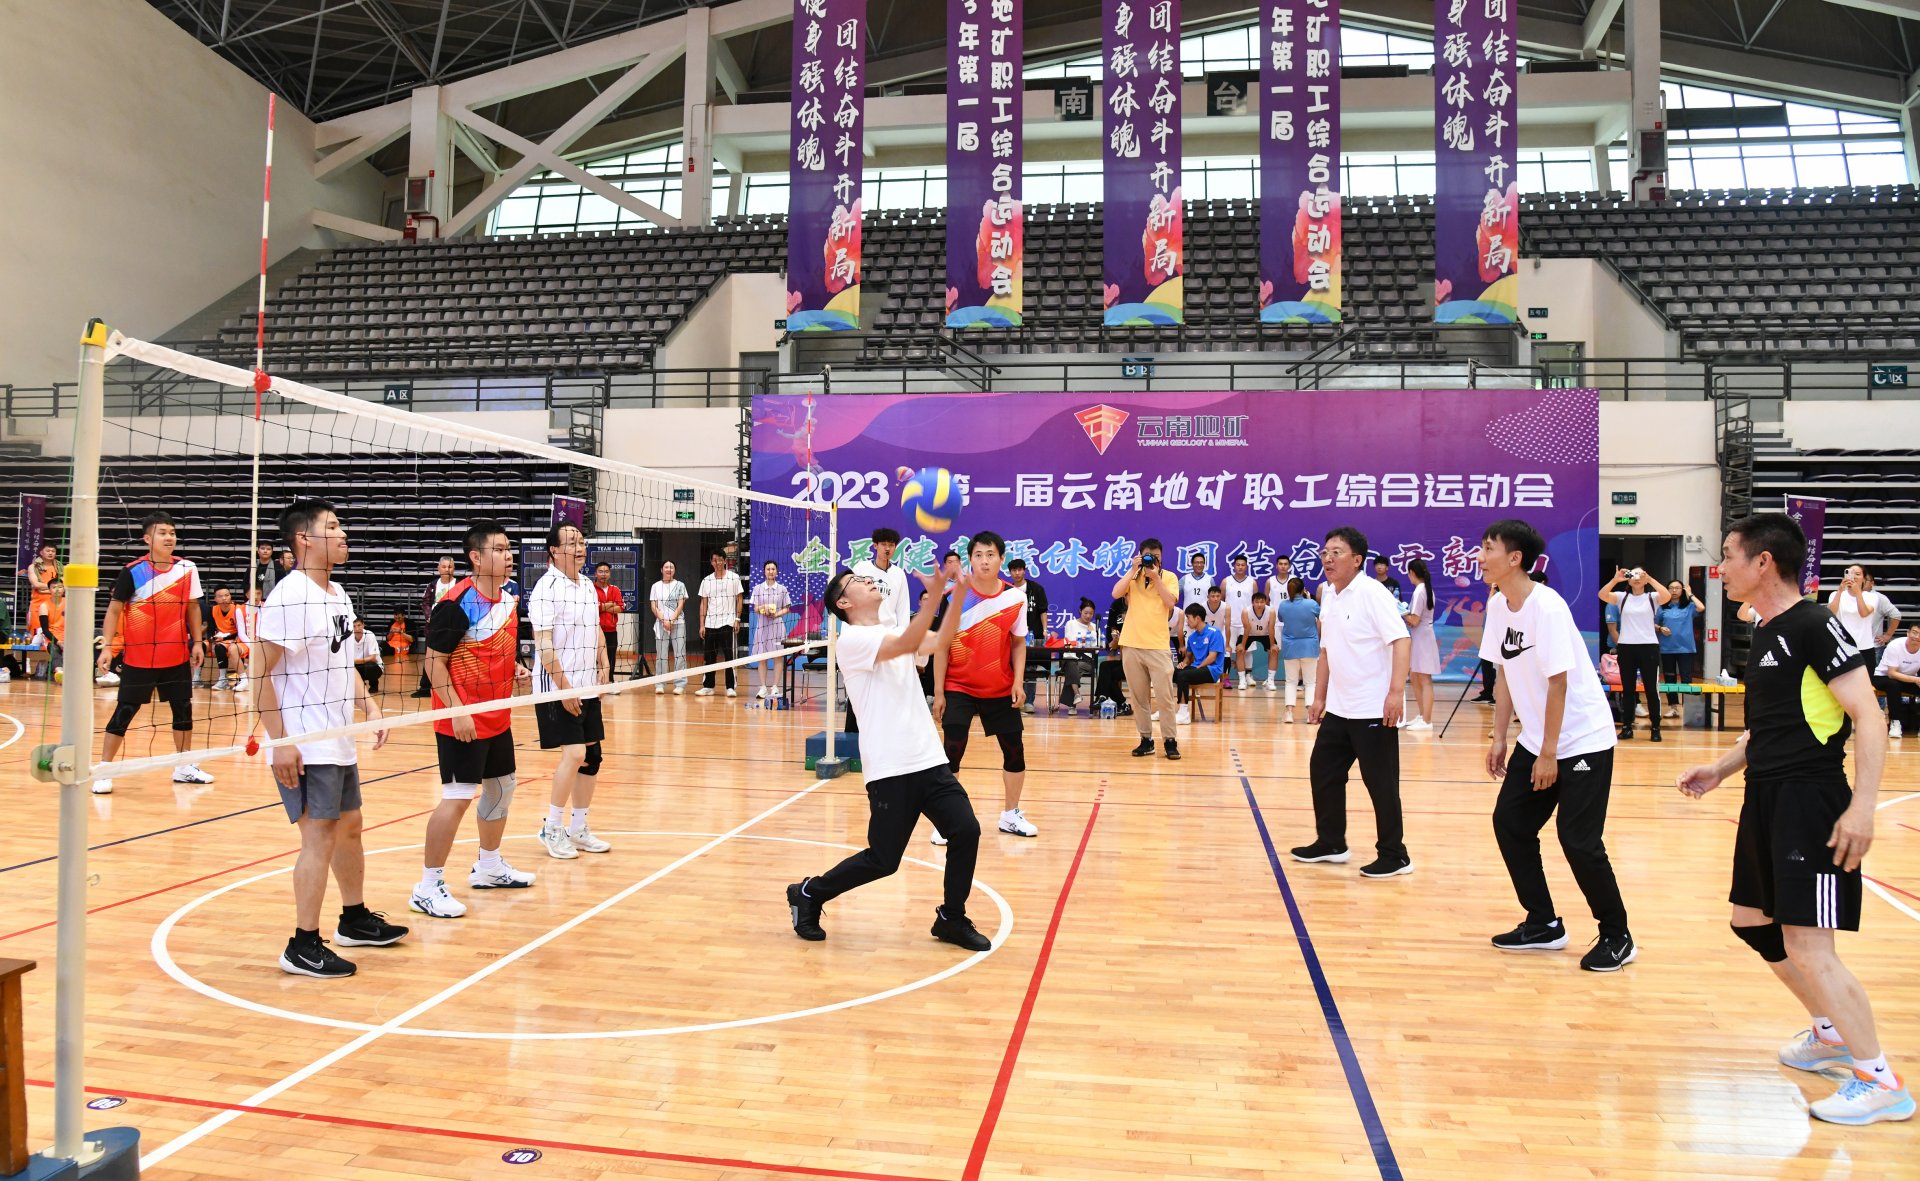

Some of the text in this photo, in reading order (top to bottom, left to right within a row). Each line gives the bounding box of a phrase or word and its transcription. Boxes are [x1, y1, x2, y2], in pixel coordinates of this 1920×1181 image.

[1060, 81, 1239, 115] 南 台
[1109, 2, 1140, 158] 身强体魄
[1271, 7, 1294, 142] 年第一届
[829, 19, 858, 284] 团结奋斗开新局
[1148, 1, 1177, 276] 团结奋斗开新局
[1306, 0, 1331, 290] 矿职工综合运动会
[1137, 415, 1249, 437] 云南地矿
[1176, 535, 1549, 580] 团结奋开新
[1194, 588, 1201, 596] 12
[509, 1152, 535, 1163] 10
